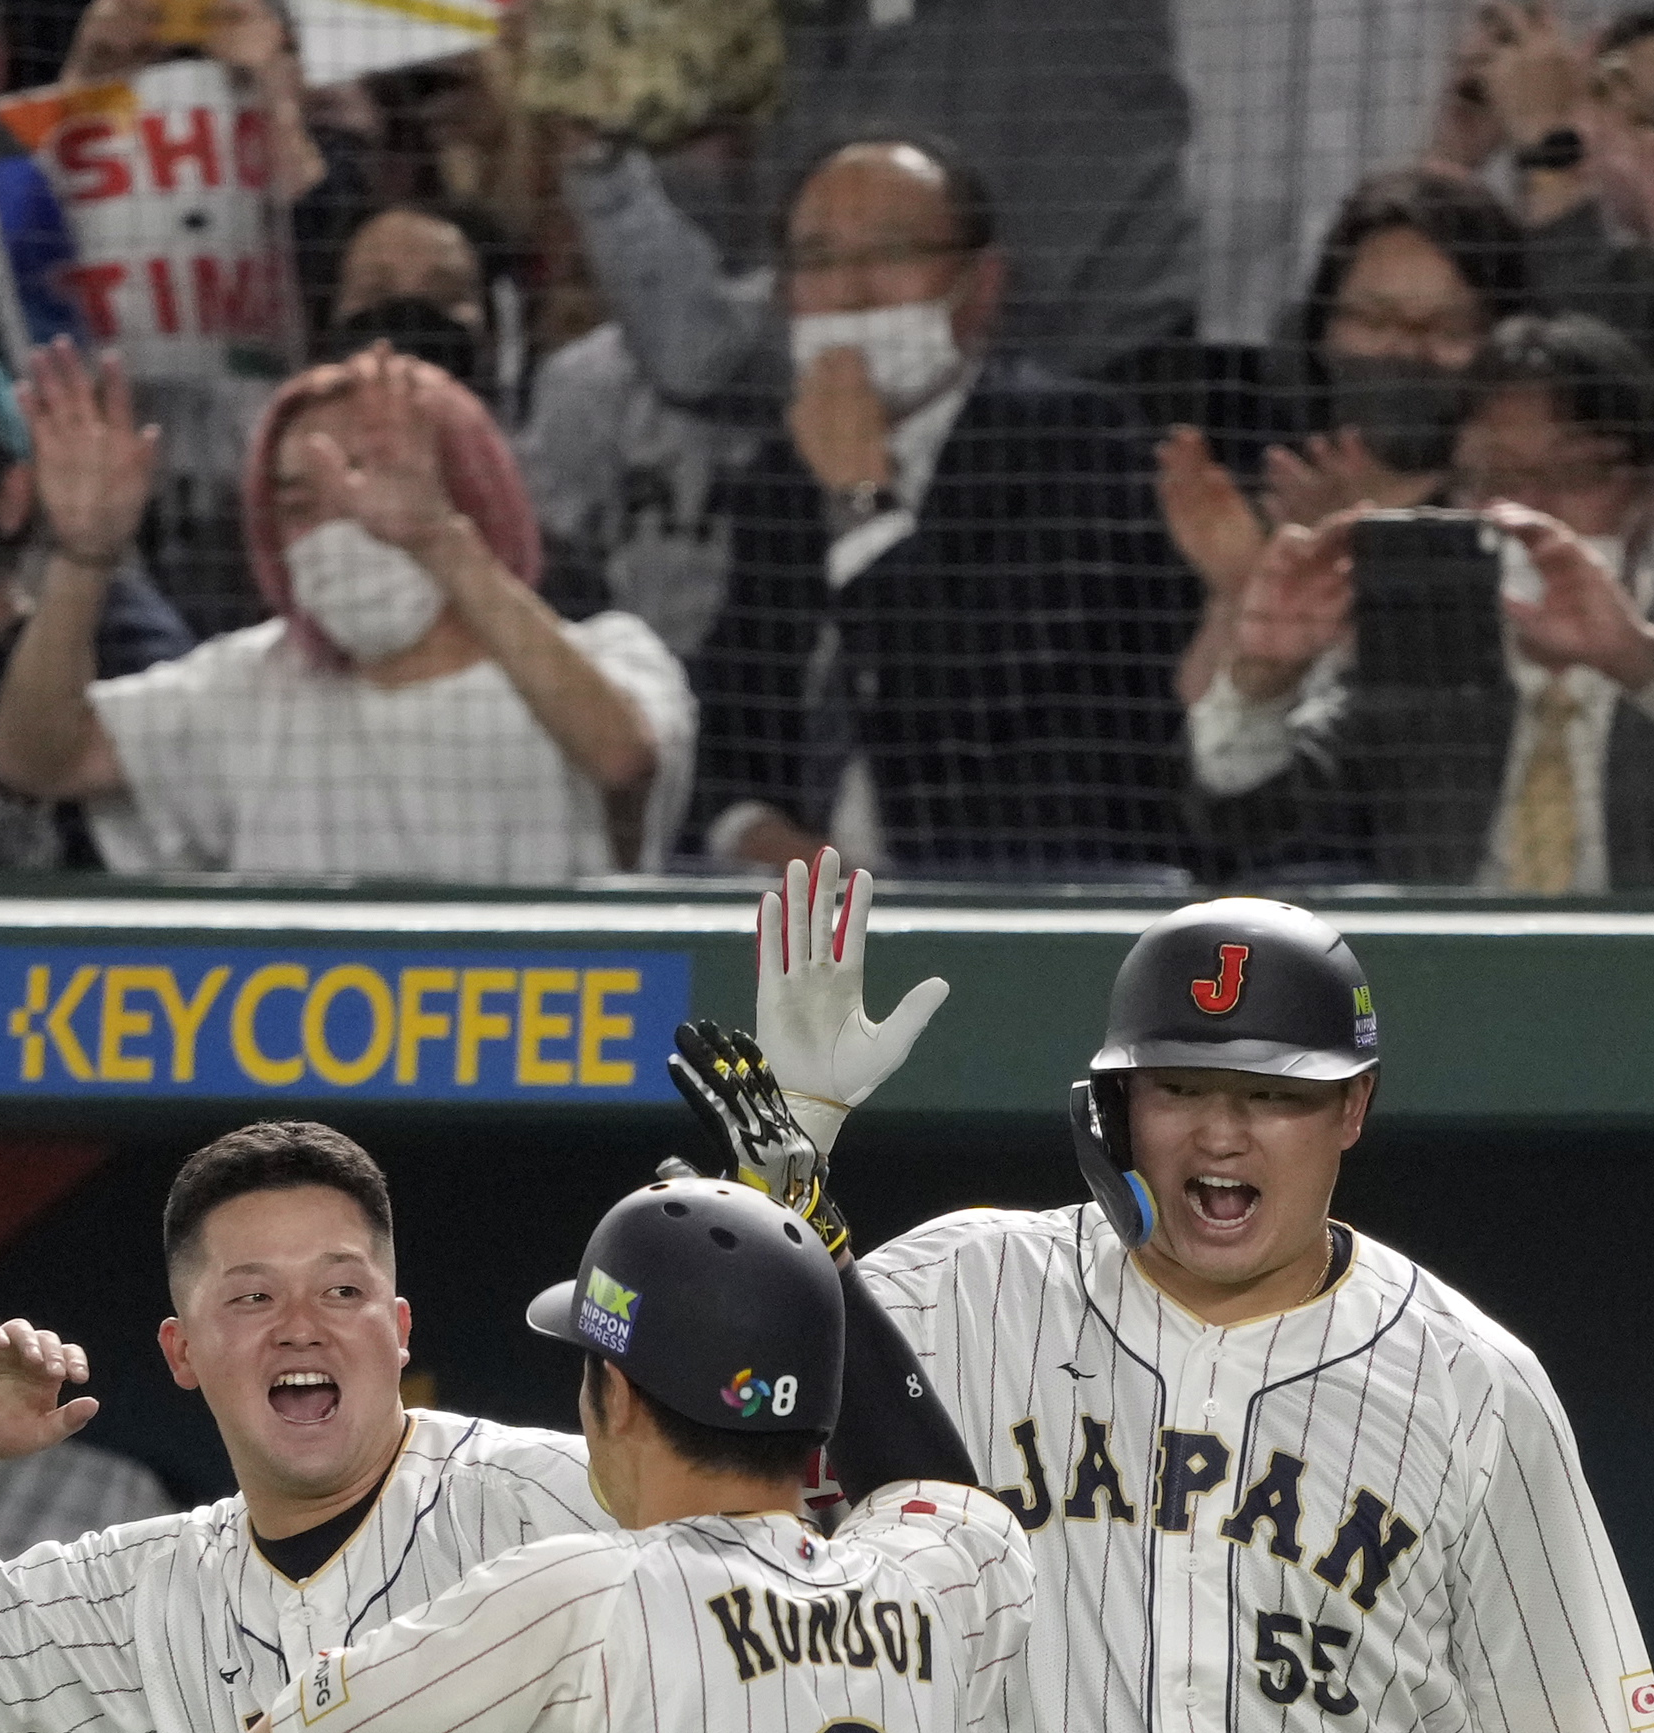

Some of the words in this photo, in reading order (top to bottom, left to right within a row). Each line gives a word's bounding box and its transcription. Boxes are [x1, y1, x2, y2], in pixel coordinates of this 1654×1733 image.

[1191, 942, 1250, 1016] J
[578, 1315, 627, 1354] EXPRESS
[580, 1299, 630, 1341] NIPPON
[771, 1374, 797, 1417] 8
[904, 1372, 925, 1398] 8
[995, 1413, 1421, 1613] JAPAN
[1253, 1611, 1361, 1717] 55
